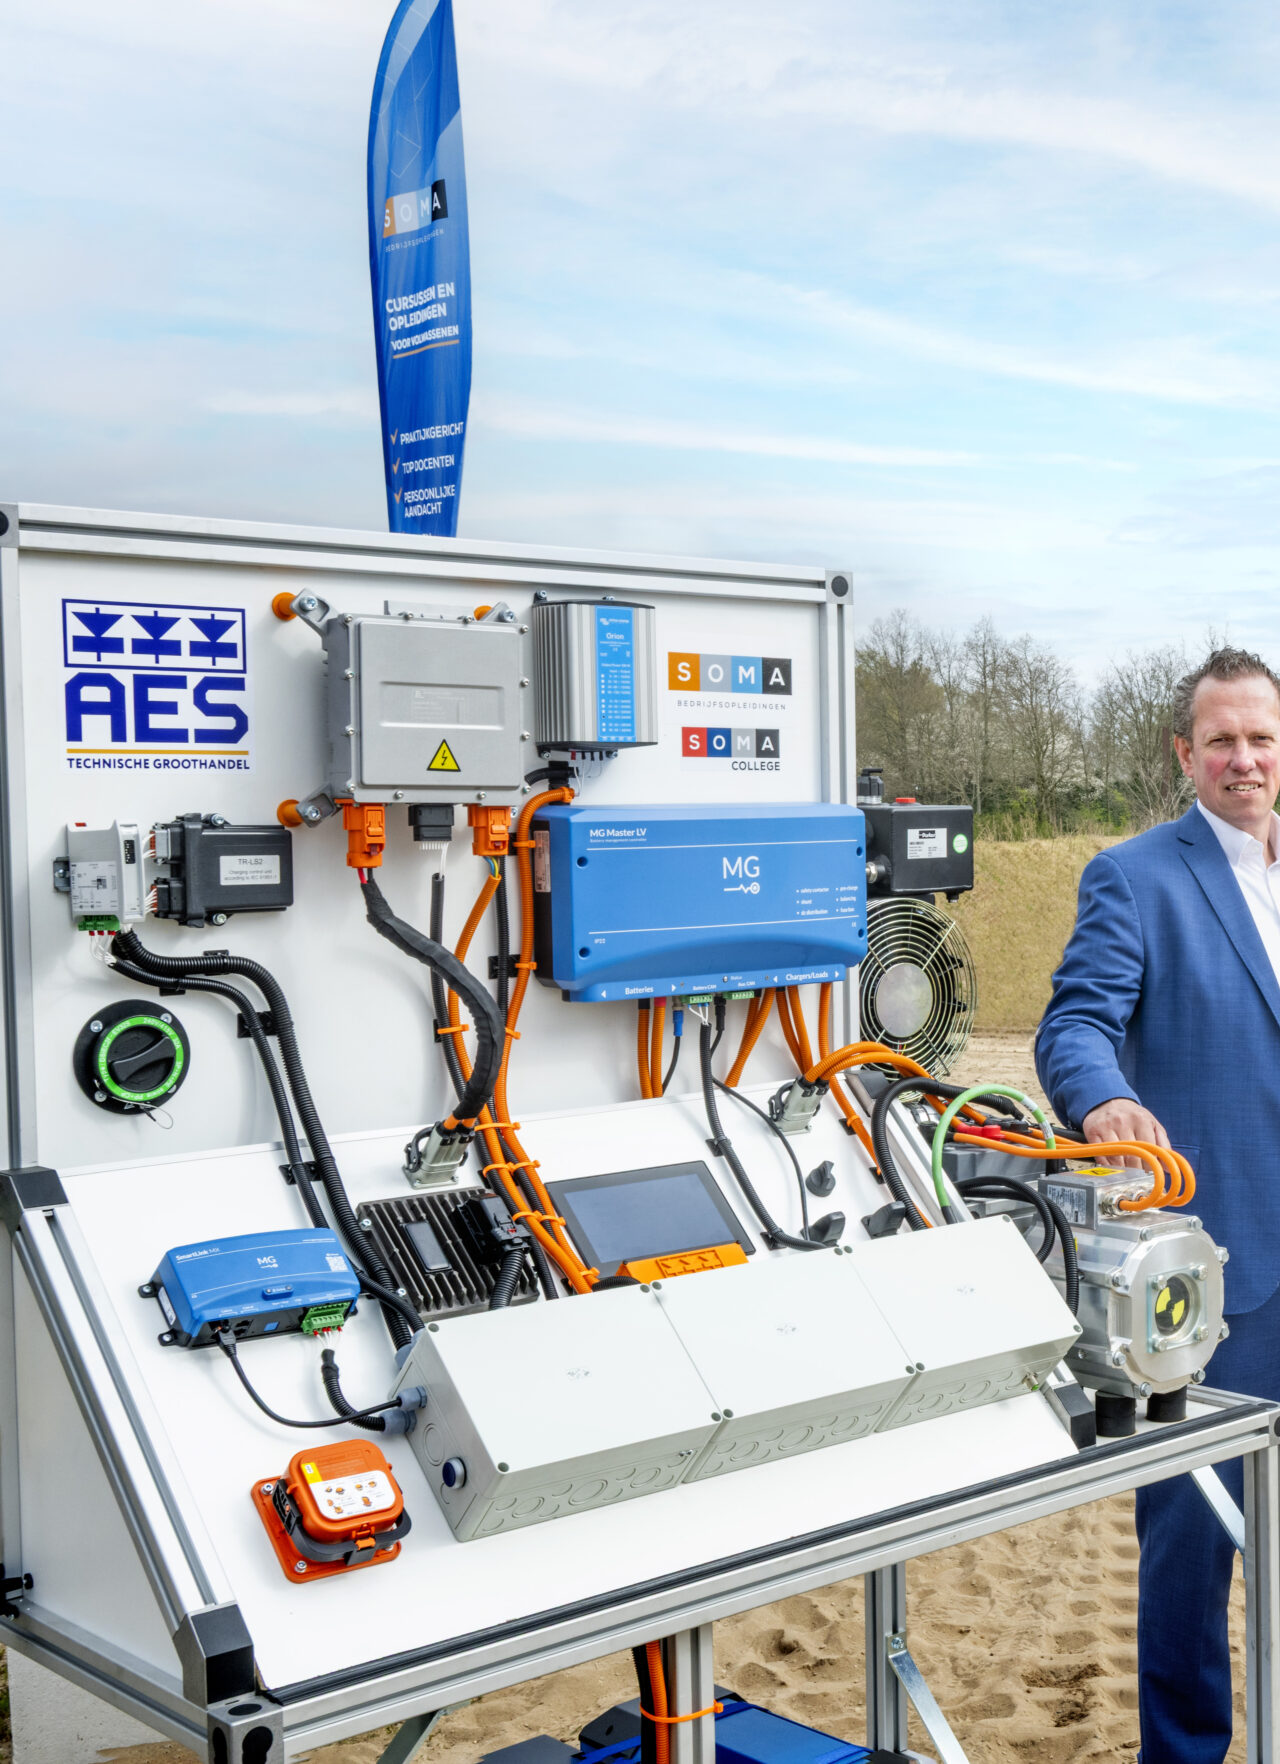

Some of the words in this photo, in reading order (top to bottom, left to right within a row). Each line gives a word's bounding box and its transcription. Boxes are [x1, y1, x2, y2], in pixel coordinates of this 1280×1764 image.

[384, 191, 441, 228] SOMA
[385, 285, 436, 313] CURSUSSEN
[437, 282, 455, 298] EN
[389, 302, 447, 331] OPLEIDINGEN
[400, 422, 464, 445] PRAKTIJKGERICHT
[404, 484, 455, 503] PERSOONLIJKE
[404, 501, 442, 518] AANDACHT
[677, 661, 785, 686] SOMA
[65, 672, 249, 744] AES
[677, 700, 785, 710] BEDRIJFSOPLEIDINGEN
[688, 734, 774, 751] SOMA
[67, 758, 150, 769] TECHNISCHE
[153, 758, 250, 770] GROOTHANDEL
[731, 761, 780, 771] COLLEGE
[590, 829, 605, 837] MG
[606, 828, 635, 837] Master
[636, 828, 647, 836] LV
[723, 856, 760, 879] MG
[786, 971, 828, 981] Chargers/Loads
[625, 986, 654, 995] Batteries
[176, 1249, 209, 1260] SmartLink
[256, 1255, 277, 1265] MG
